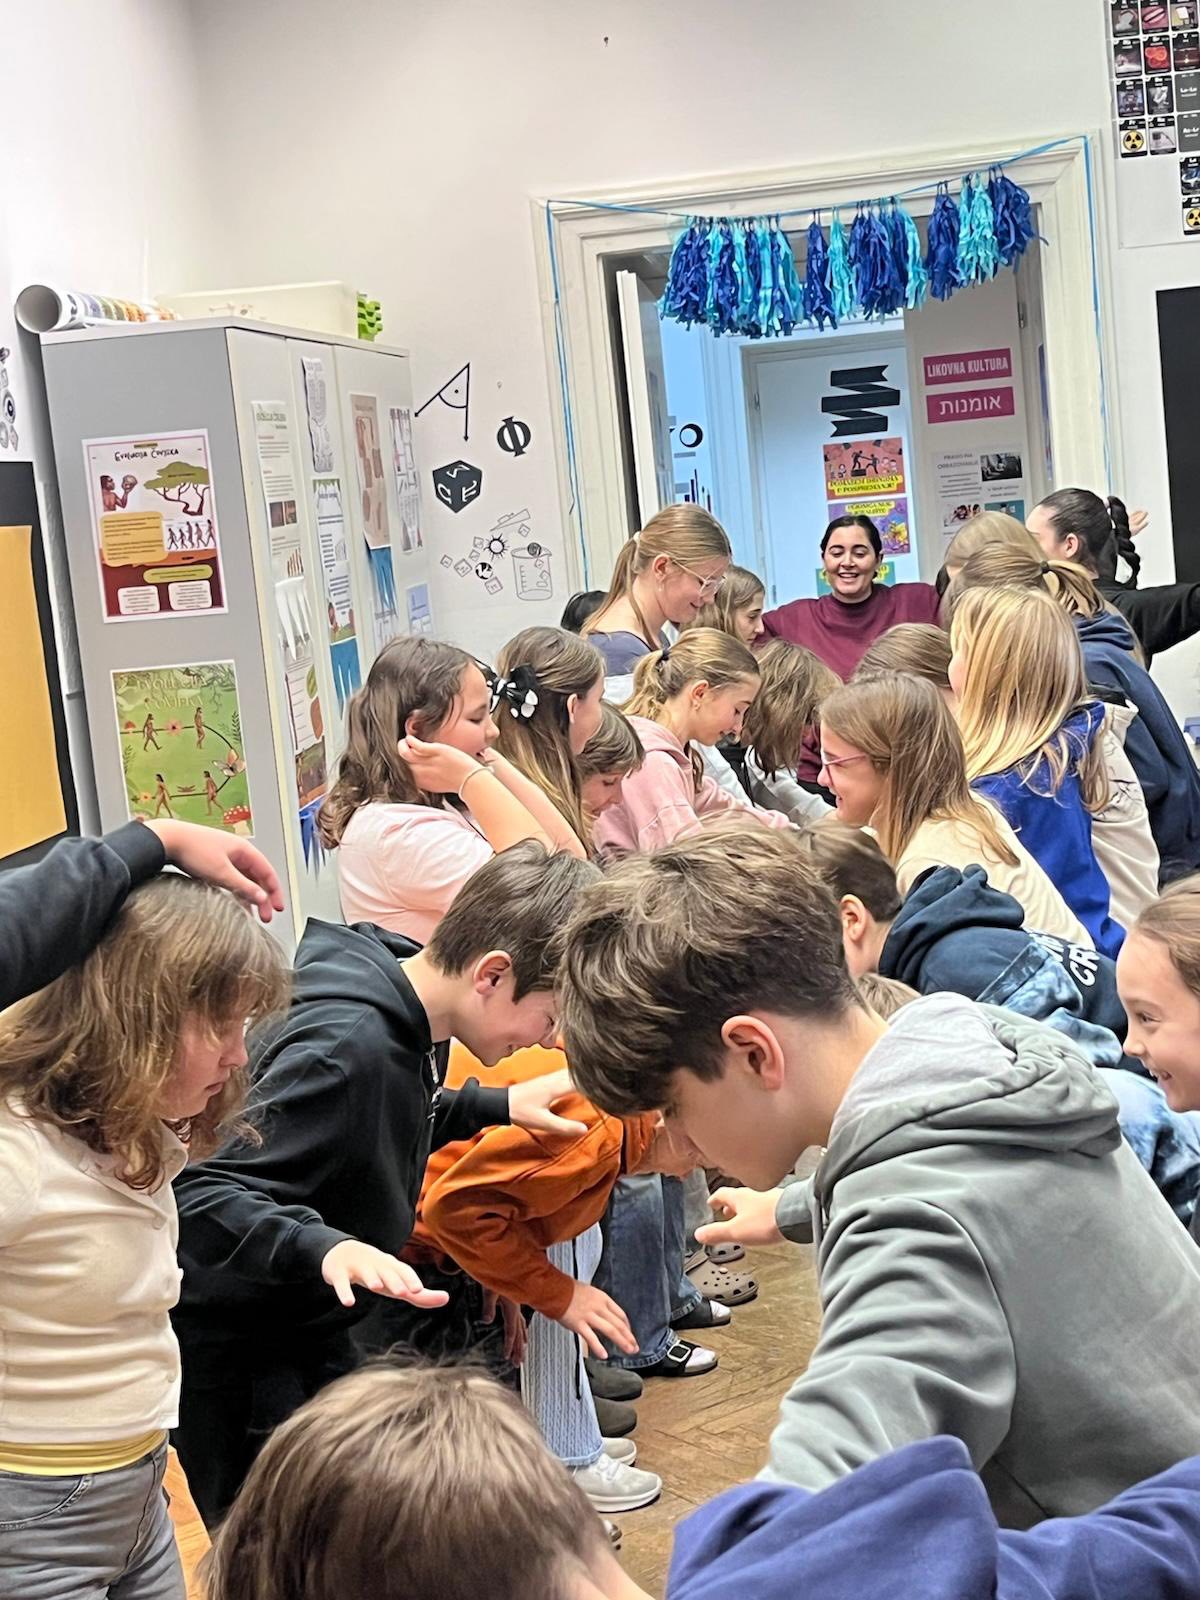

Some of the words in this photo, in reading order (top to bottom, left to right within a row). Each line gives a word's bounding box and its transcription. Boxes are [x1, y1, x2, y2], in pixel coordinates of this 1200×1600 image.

[927, 362, 966, 377] LIKOVNA
[967, 357, 1009, 373] KULTURA
[939, 395, 1002, 415] אומנות
[1067, 944, 1100, 986] CR
